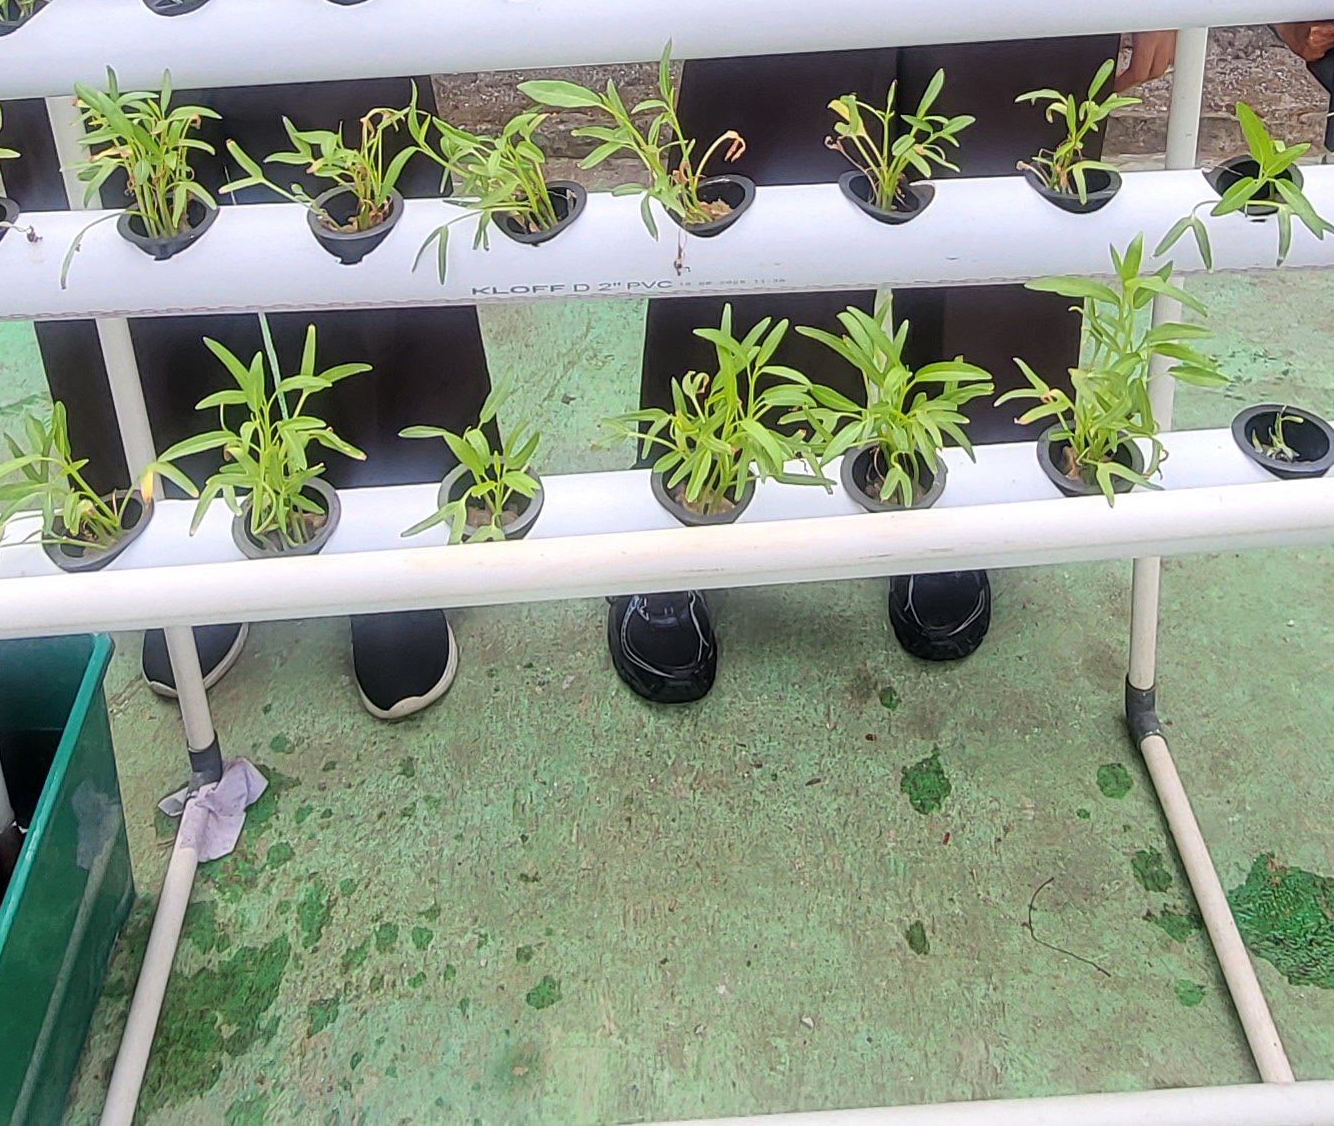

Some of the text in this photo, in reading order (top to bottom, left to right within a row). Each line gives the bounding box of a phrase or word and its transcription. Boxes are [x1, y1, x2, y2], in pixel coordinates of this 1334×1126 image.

[471, 284, 566, 296] KLOFF
[573, 283, 591, 293] D
[626, 280, 673, 290] PVC
